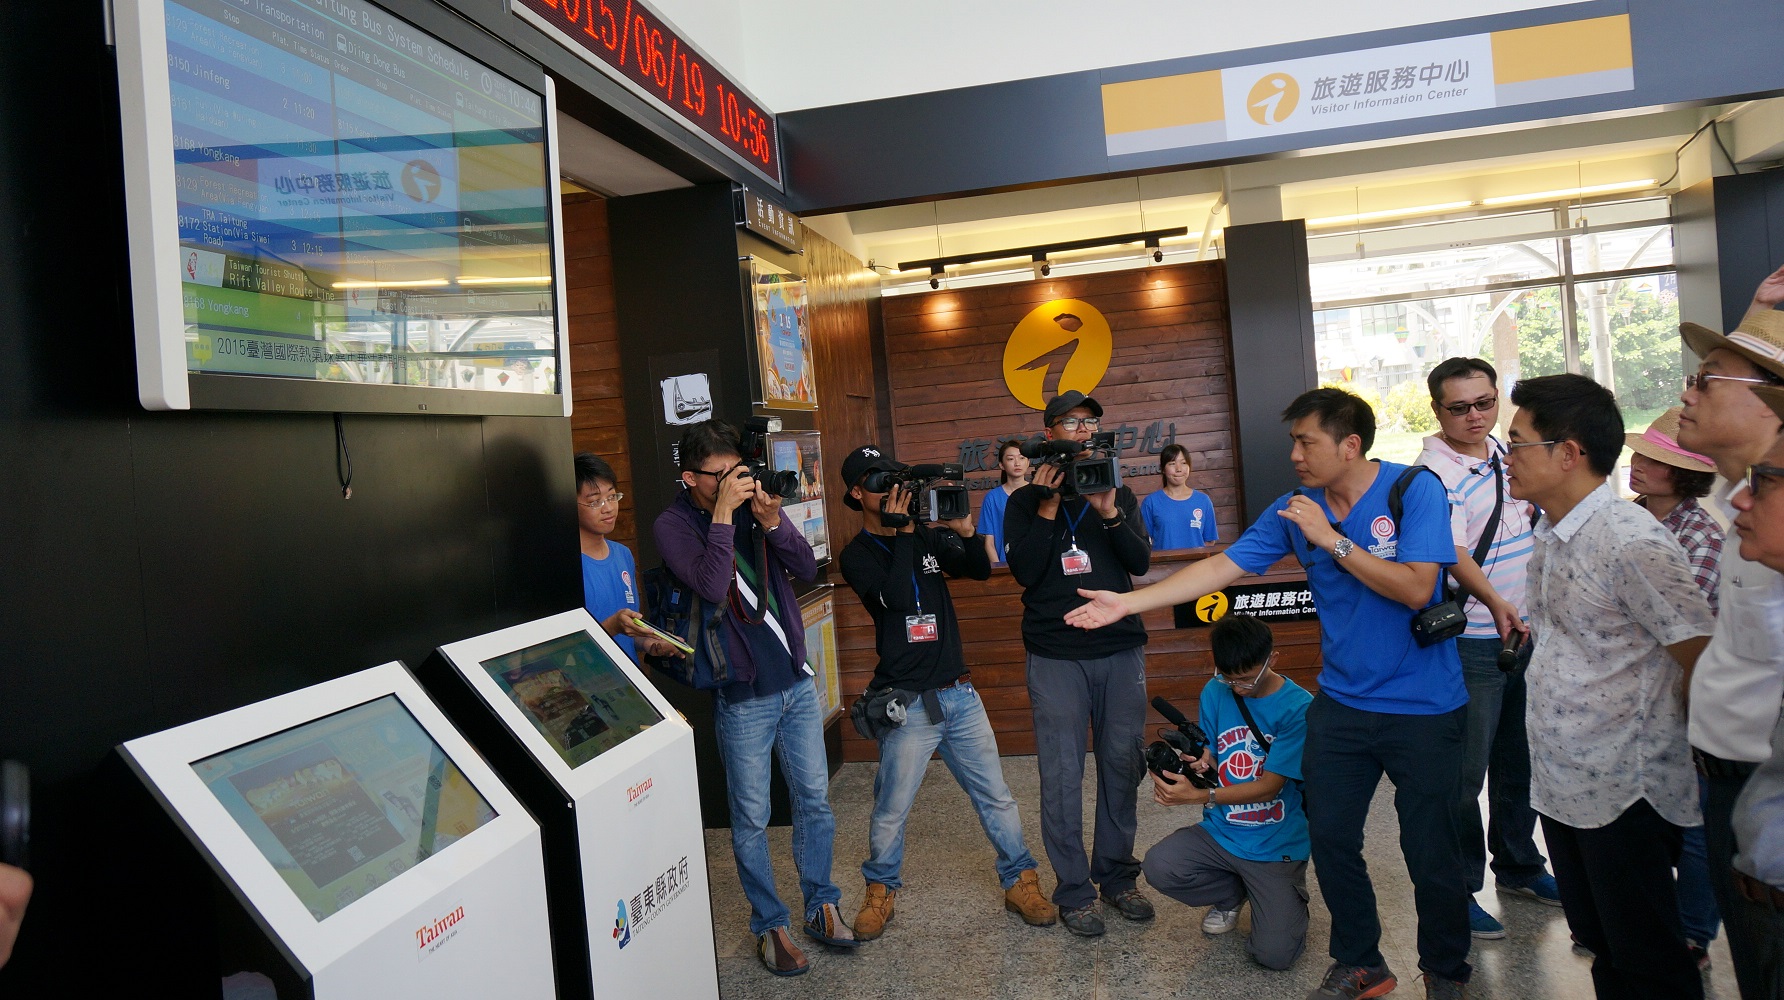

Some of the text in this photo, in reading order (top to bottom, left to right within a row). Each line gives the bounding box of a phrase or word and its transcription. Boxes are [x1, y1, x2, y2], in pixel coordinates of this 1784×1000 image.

[254, 0, 326, 41] Transportation
[222, 9, 241, 25] Stop
[293, 40, 307, 55] Time
[310, 49, 330, 65] Status
[362, 10, 382, 36] Bus
[387, 24, 423, 58] System
[427, 45, 470, 80] Schedule
[334, 58, 350, 73] Order
[373, 53, 391, 72] Dong
[393, 63, 406, 79] Bus
[1311, 58, 1470, 101] 旅遊服務中心
[168, 53, 316, 119] 8150 Jinfeng 2 11:20
[543, 0, 770, 164] 15/06/19 10:56
[508, 86, 537, 115] 10:44
[1311, 87, 1469, 115] Visitor Information Center
[173, 134, 195, 152] 8168
[197, 142, 240, 167] Yongkang
[176, 175, 198, 192] 8129
[178, 208, 248, 231] 8172 TRA Taitung
[202, 221, 323, 256] Station(Via Siwei 3 12:15
[203, 232, 224, 248] Road)
[228, 259, 308, 282] Taiwan Tourist Shuttle
[229, 273, 335, 301] Rift Valley Route Line
[208, 300, 249, 318] Yongkang
[381, 298, 397, 311] East
[1120, 462, 1163, 478] Cente
[1369, 545, 1395, 553] Taiwa
[1233, 589, 1314, 610] 旅遊服務中
[1259, 607, 1300, 617] Information
[1302, 606, 1317, 614] Cen
[626, 777, 653, 803] Taiwan
[630, 855, 689, 928] 臺東縣政府
[632, 881, 691, 938] TAITUNG COUNTY GOVERNMENT
[416, 905, 465, 949] Taiwan
